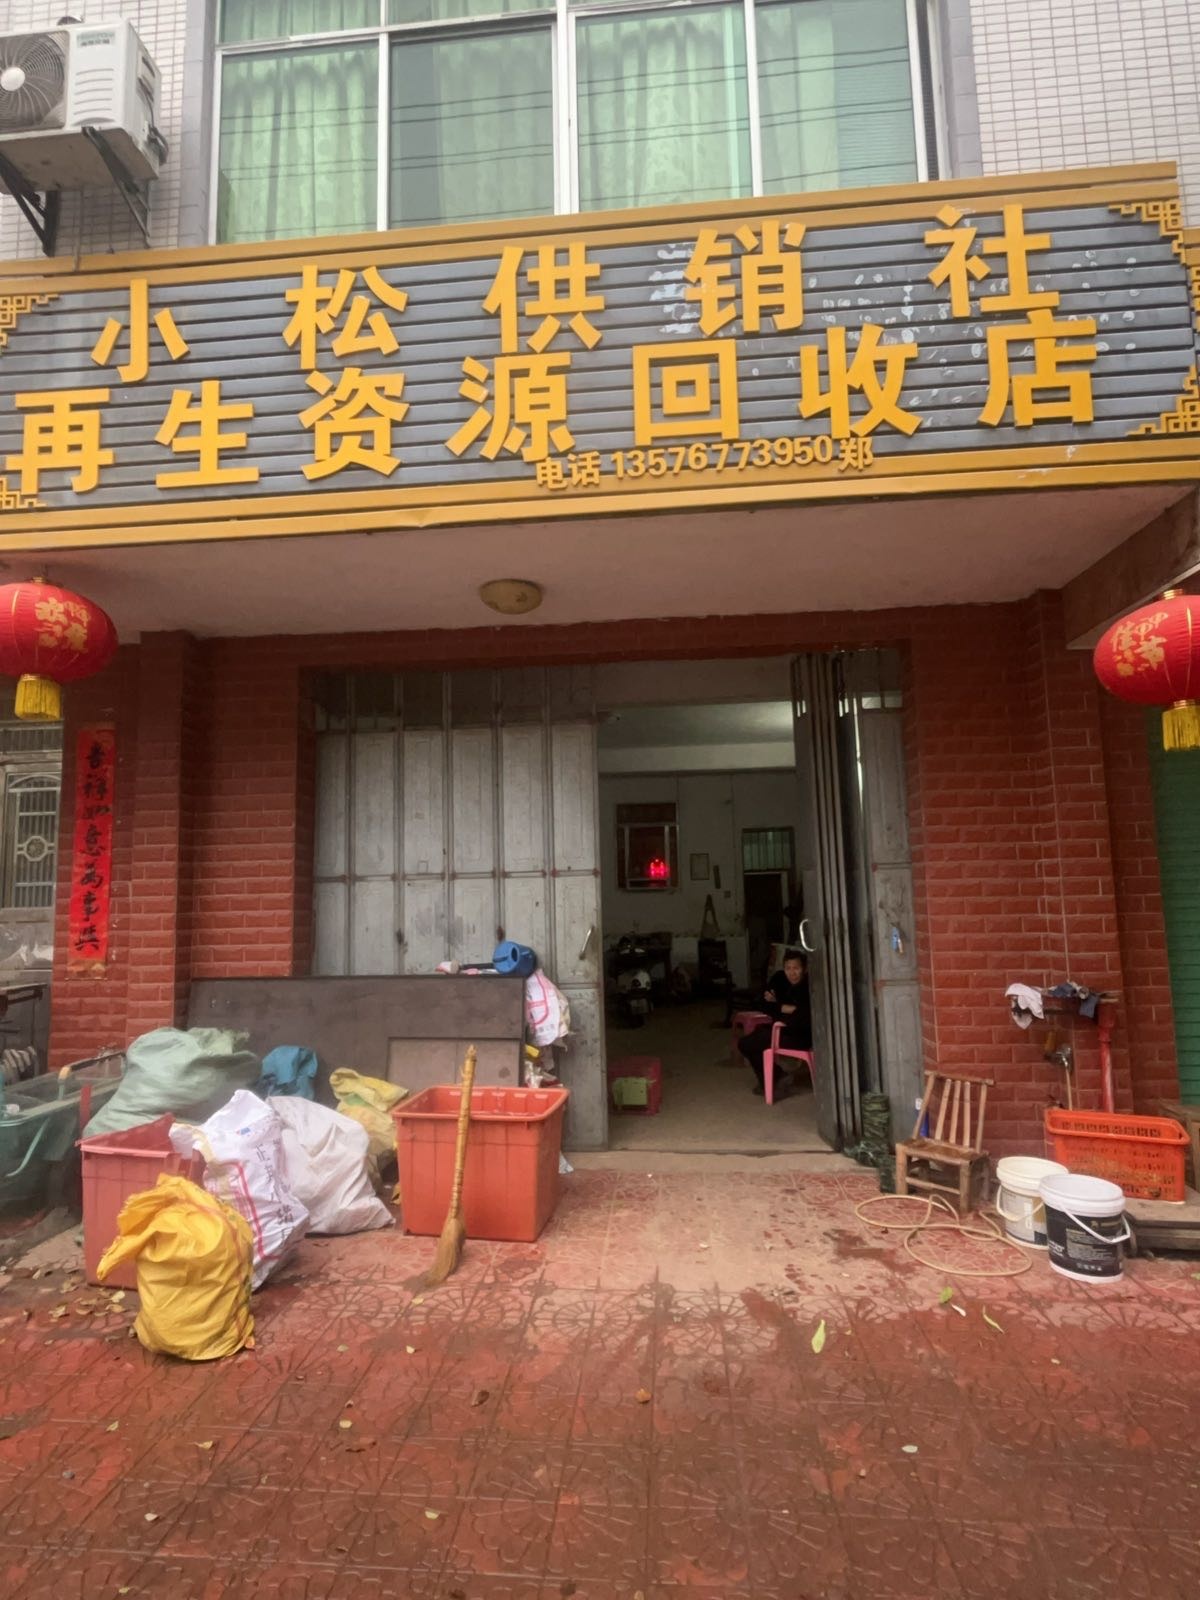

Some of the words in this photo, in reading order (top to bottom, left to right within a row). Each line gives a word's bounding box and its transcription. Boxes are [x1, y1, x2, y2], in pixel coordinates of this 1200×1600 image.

[91, 204, 1060, 384] 小松供销社
[5, 309, 1098, 496] 再生资源回收店
